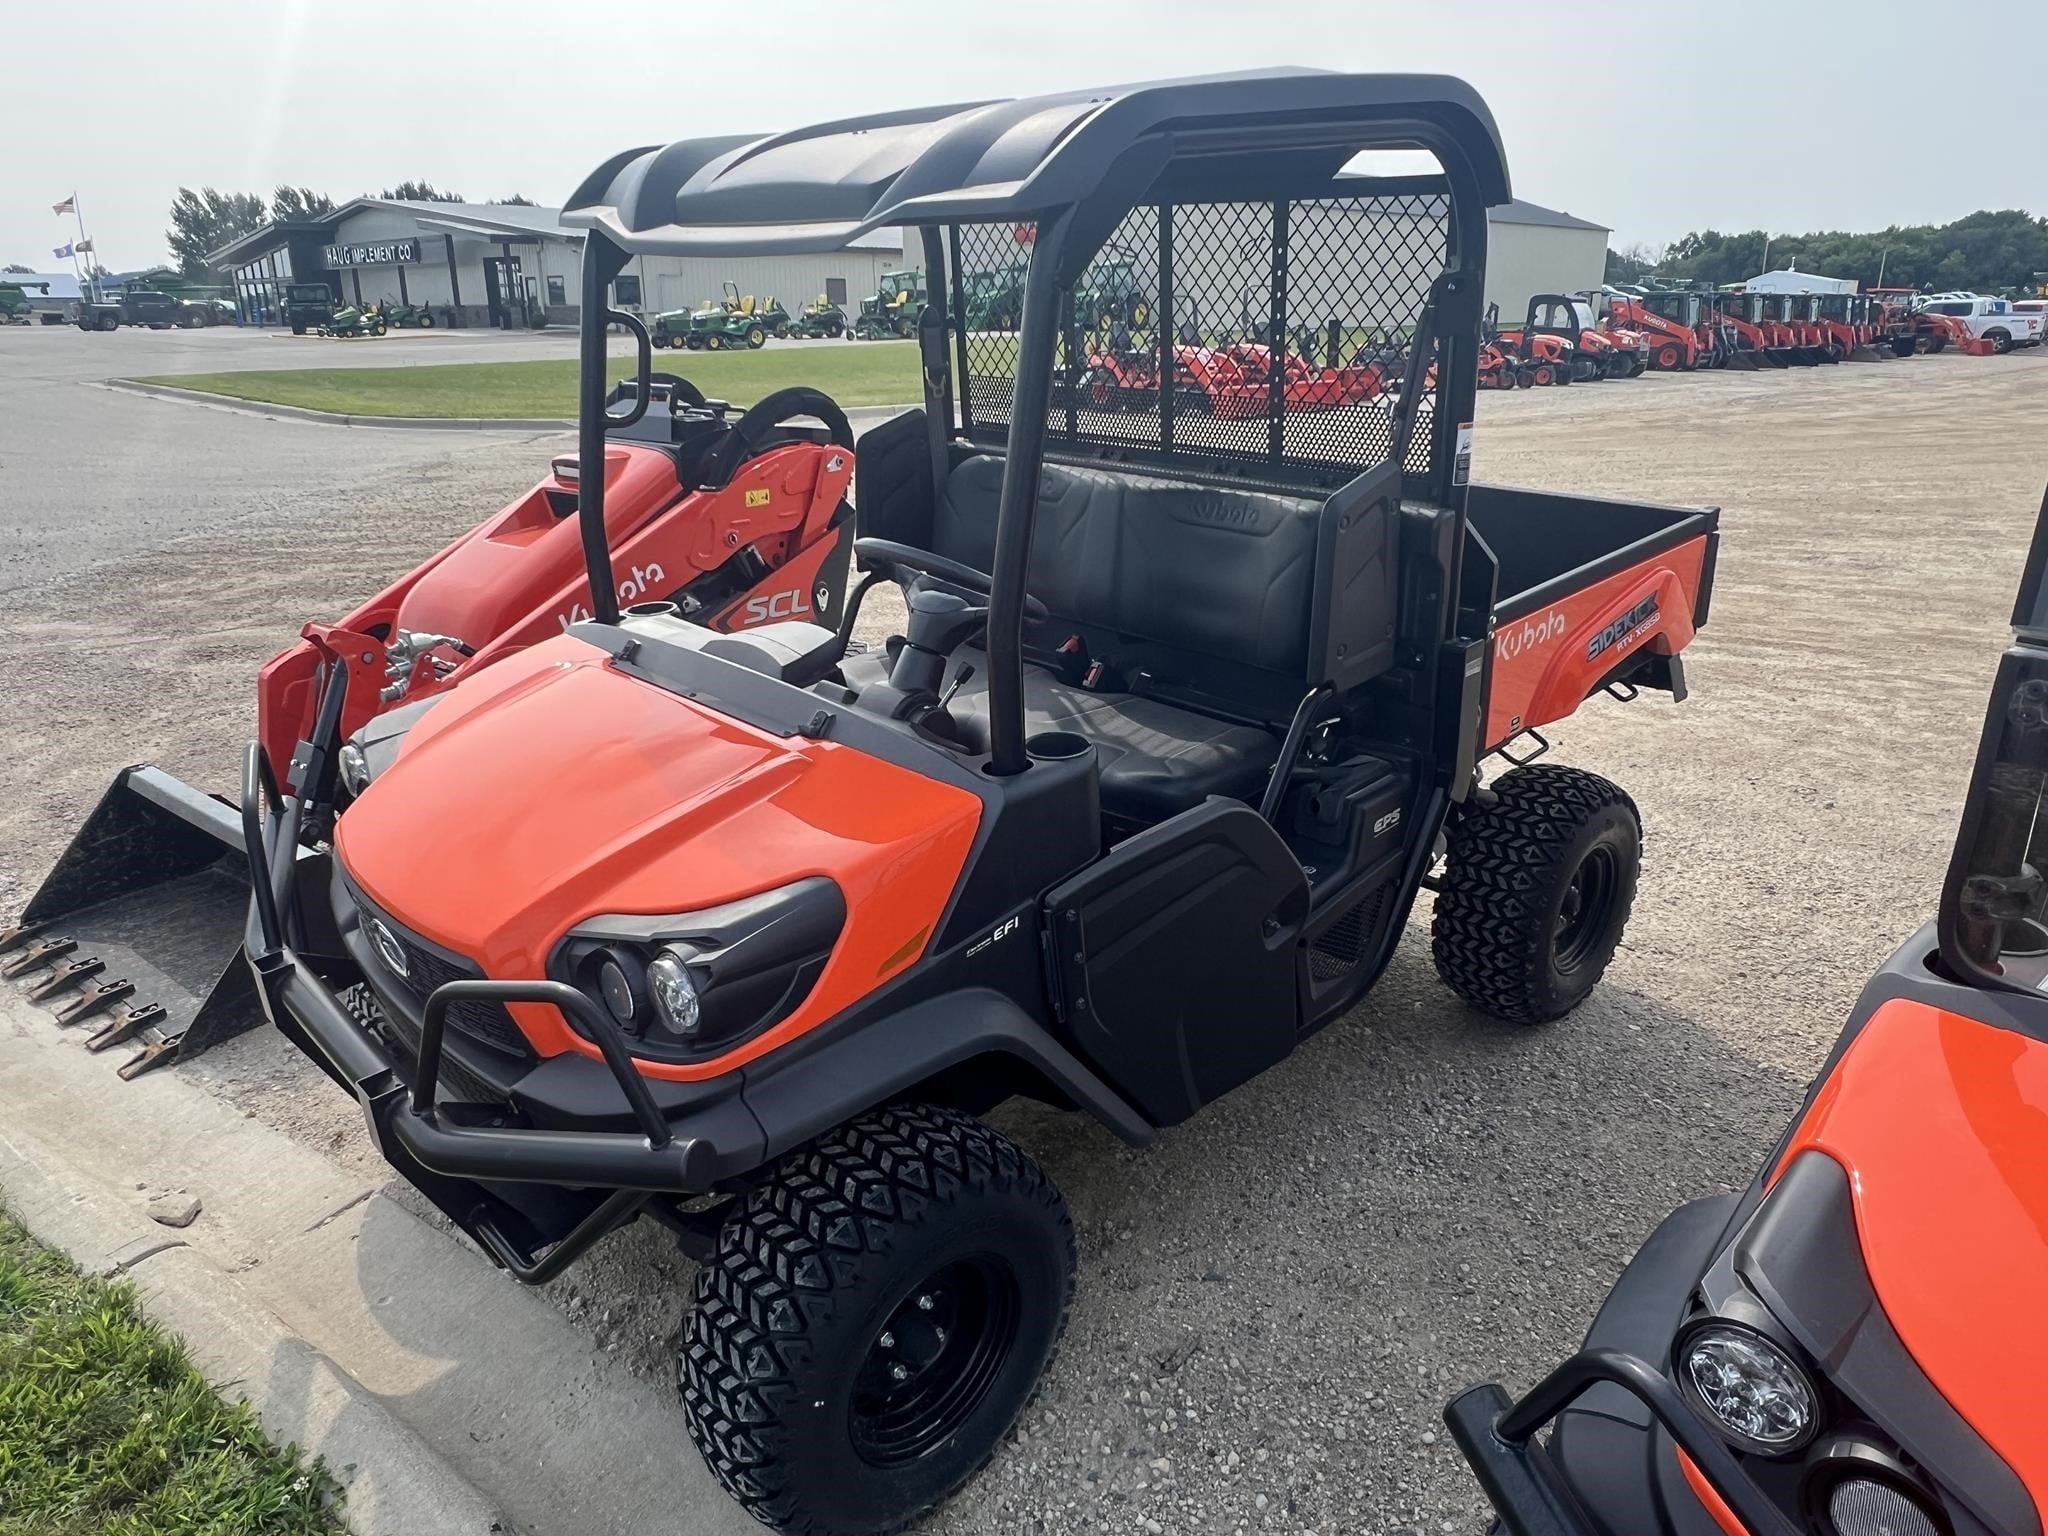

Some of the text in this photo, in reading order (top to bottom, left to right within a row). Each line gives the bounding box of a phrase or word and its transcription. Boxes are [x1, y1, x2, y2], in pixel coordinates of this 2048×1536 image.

[326, 244, 411, 265] HAUG IMPLEMENT CO
[744, 589, 809, 624] SCL
[1495, 610, 1566, 660] Kubota
[1373, 807, 1401, 833] EPS
[993, 915, 1019, 941] EFI
